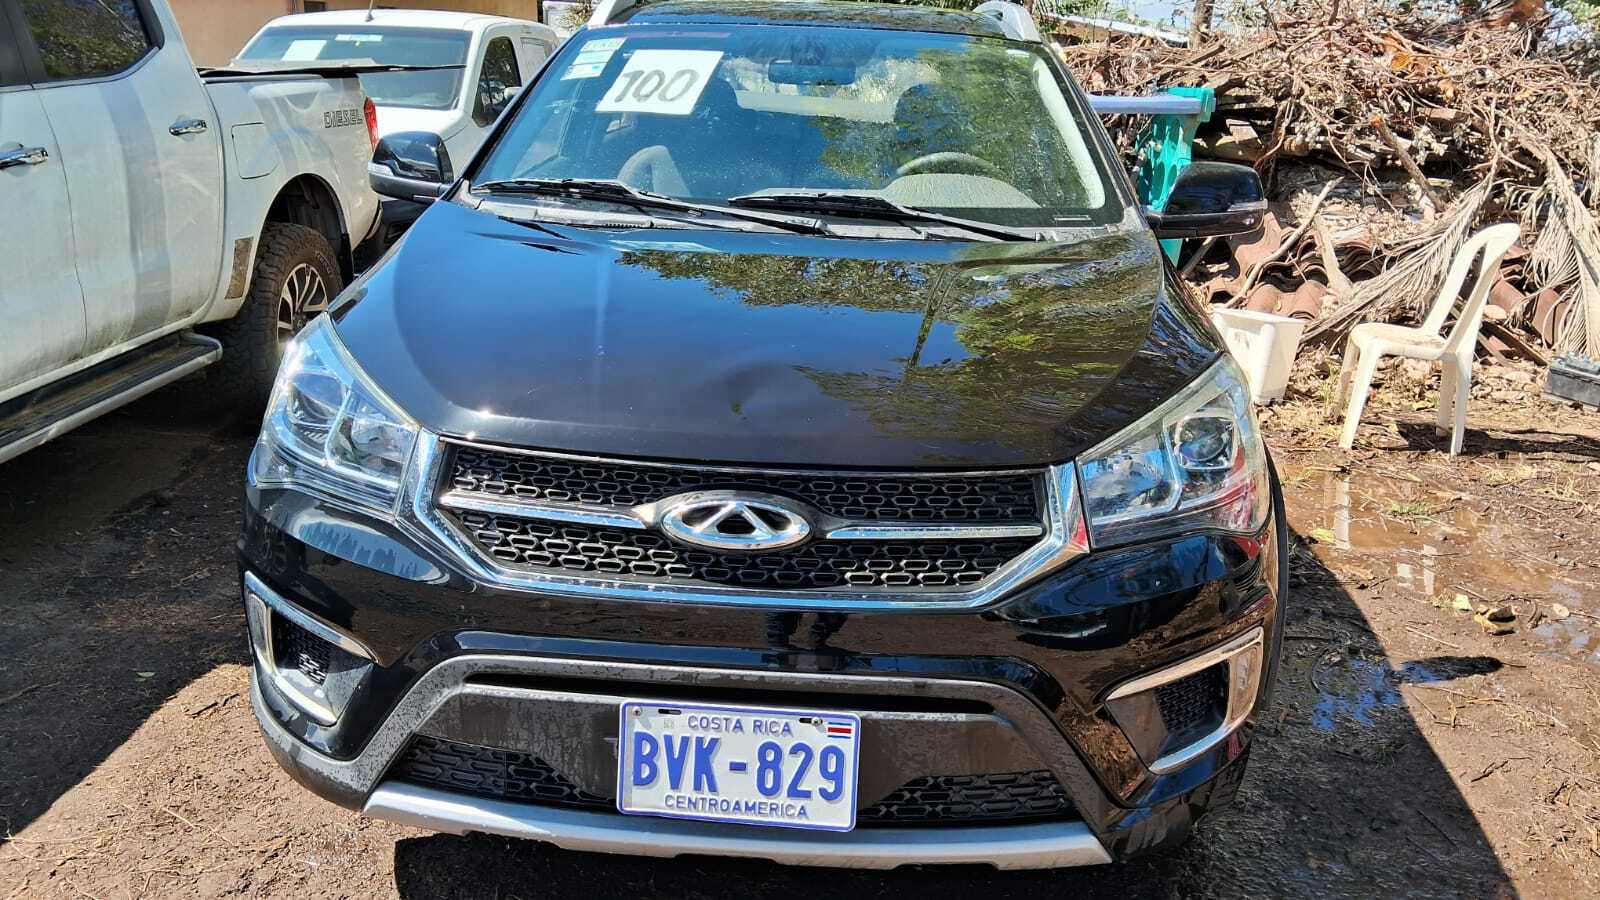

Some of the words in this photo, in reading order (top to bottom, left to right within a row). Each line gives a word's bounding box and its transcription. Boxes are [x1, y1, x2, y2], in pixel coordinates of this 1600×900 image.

[614, 69, 699, 102] 100
[323, 109, 363, 129] DIESEL
[687, 715, 744, 733] COSTA
[752, 720, 793, 736] RICA
[633, 731, 845, 801] BVK-829
[665, 795, 807, 818] CENTROAMERICA
